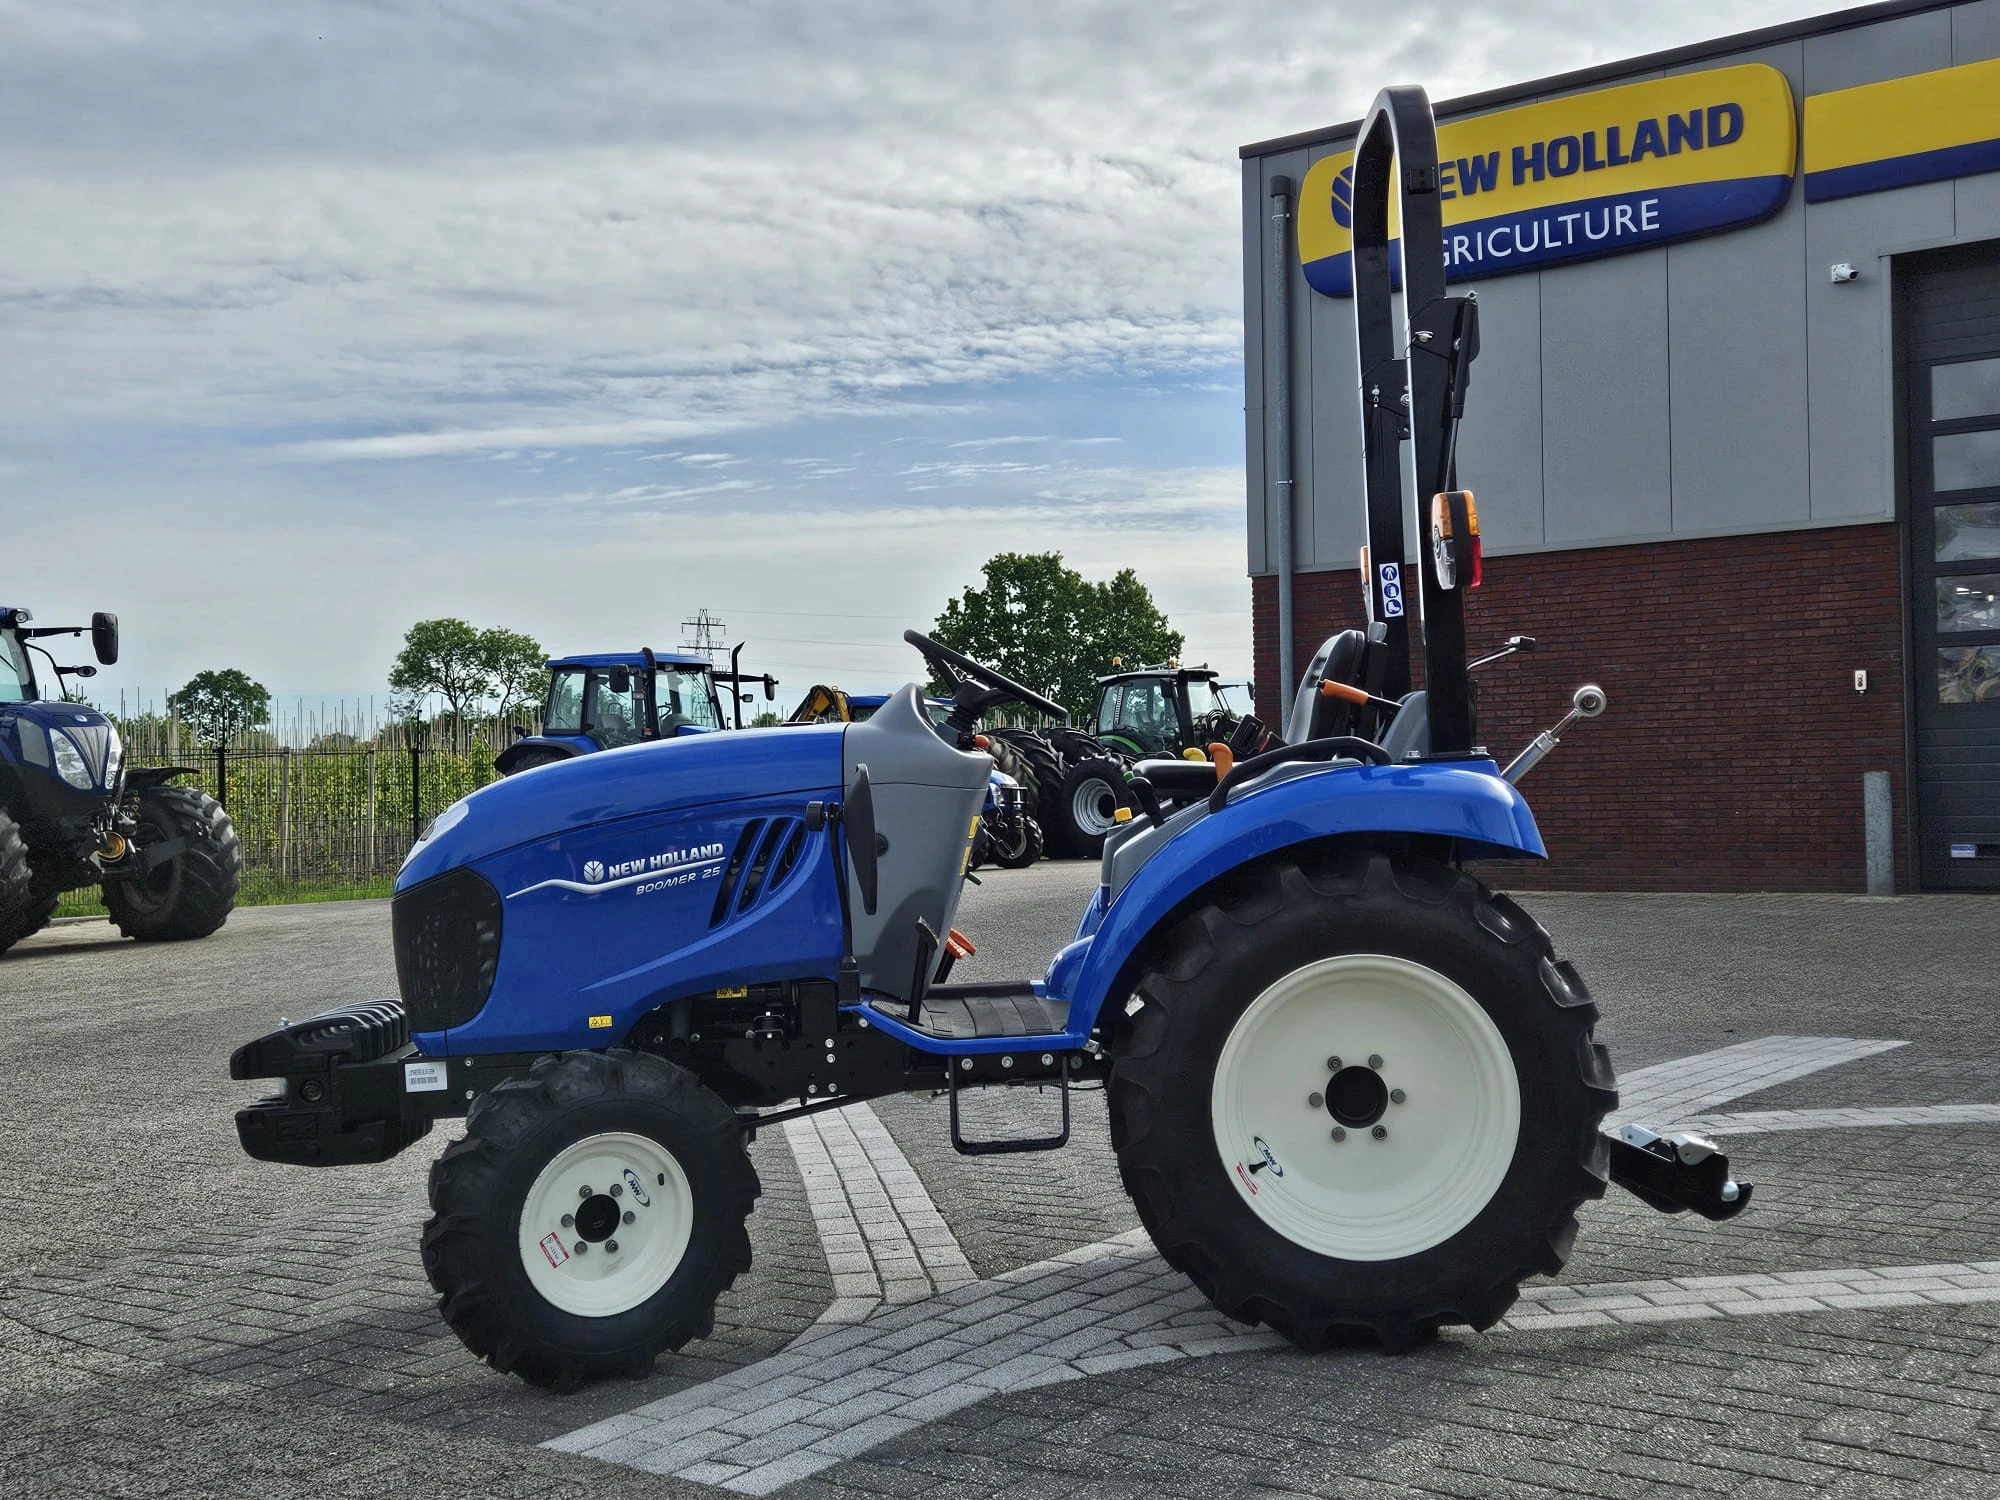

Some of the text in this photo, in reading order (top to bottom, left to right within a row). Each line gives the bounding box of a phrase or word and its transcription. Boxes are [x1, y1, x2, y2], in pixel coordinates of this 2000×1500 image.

[1438, 102, 1744, 200] EW HOLLAND
[1442, 199, 1660, 267] RICULTURE
[608, 843, 724, 879] NEW HOLLAND
[635, 866, 721, 896] BOOMER 25
